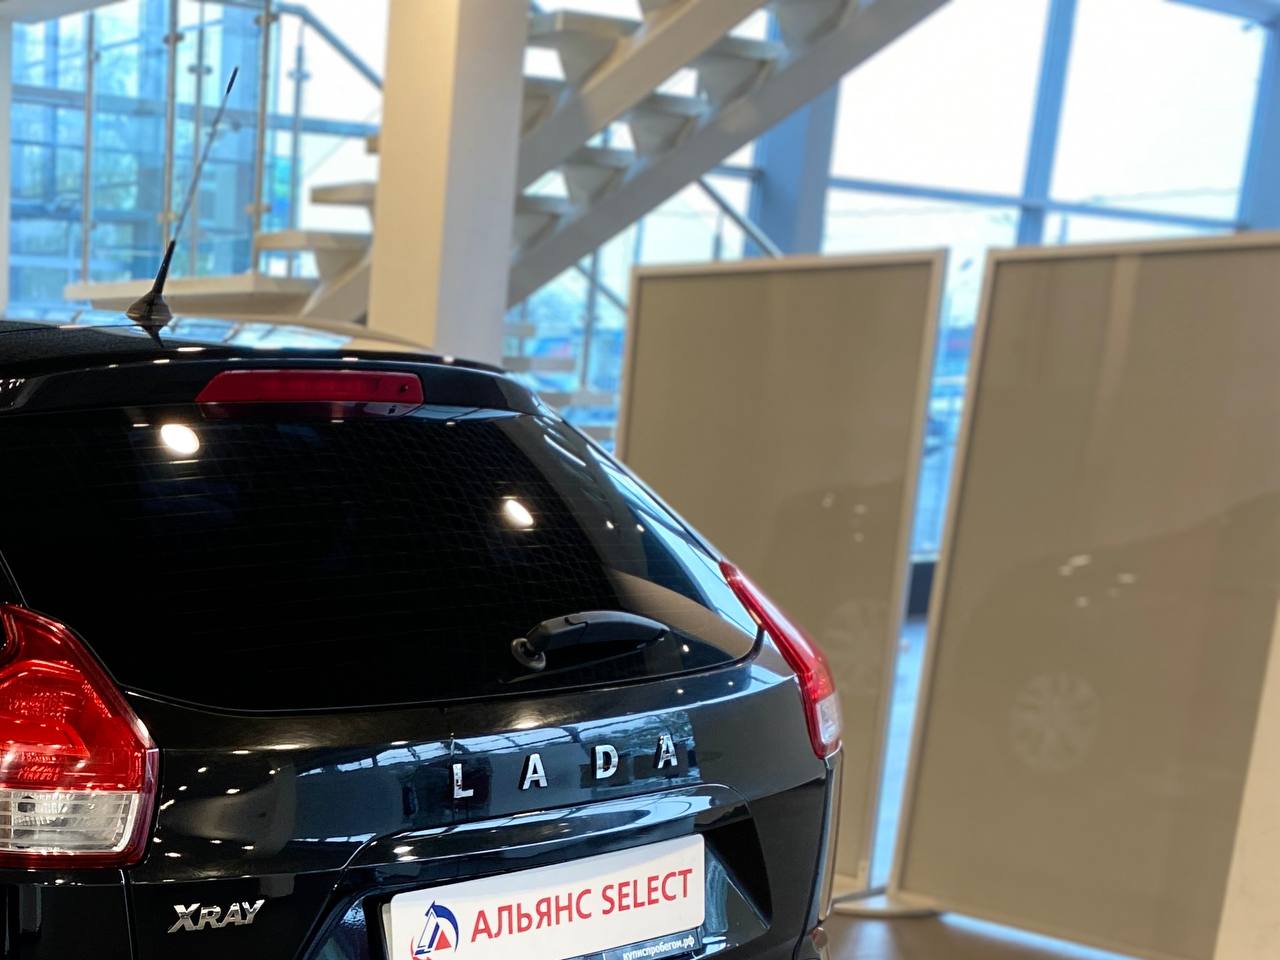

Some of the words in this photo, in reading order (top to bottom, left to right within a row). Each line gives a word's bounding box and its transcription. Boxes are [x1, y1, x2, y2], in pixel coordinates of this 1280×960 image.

[451, 734, 678, 799] LADA
[167, 899, 265, 934] XRAY
[470, 888, 592, 942] АЛЬЯНС
[601, 868, 693, 915] SELECT
